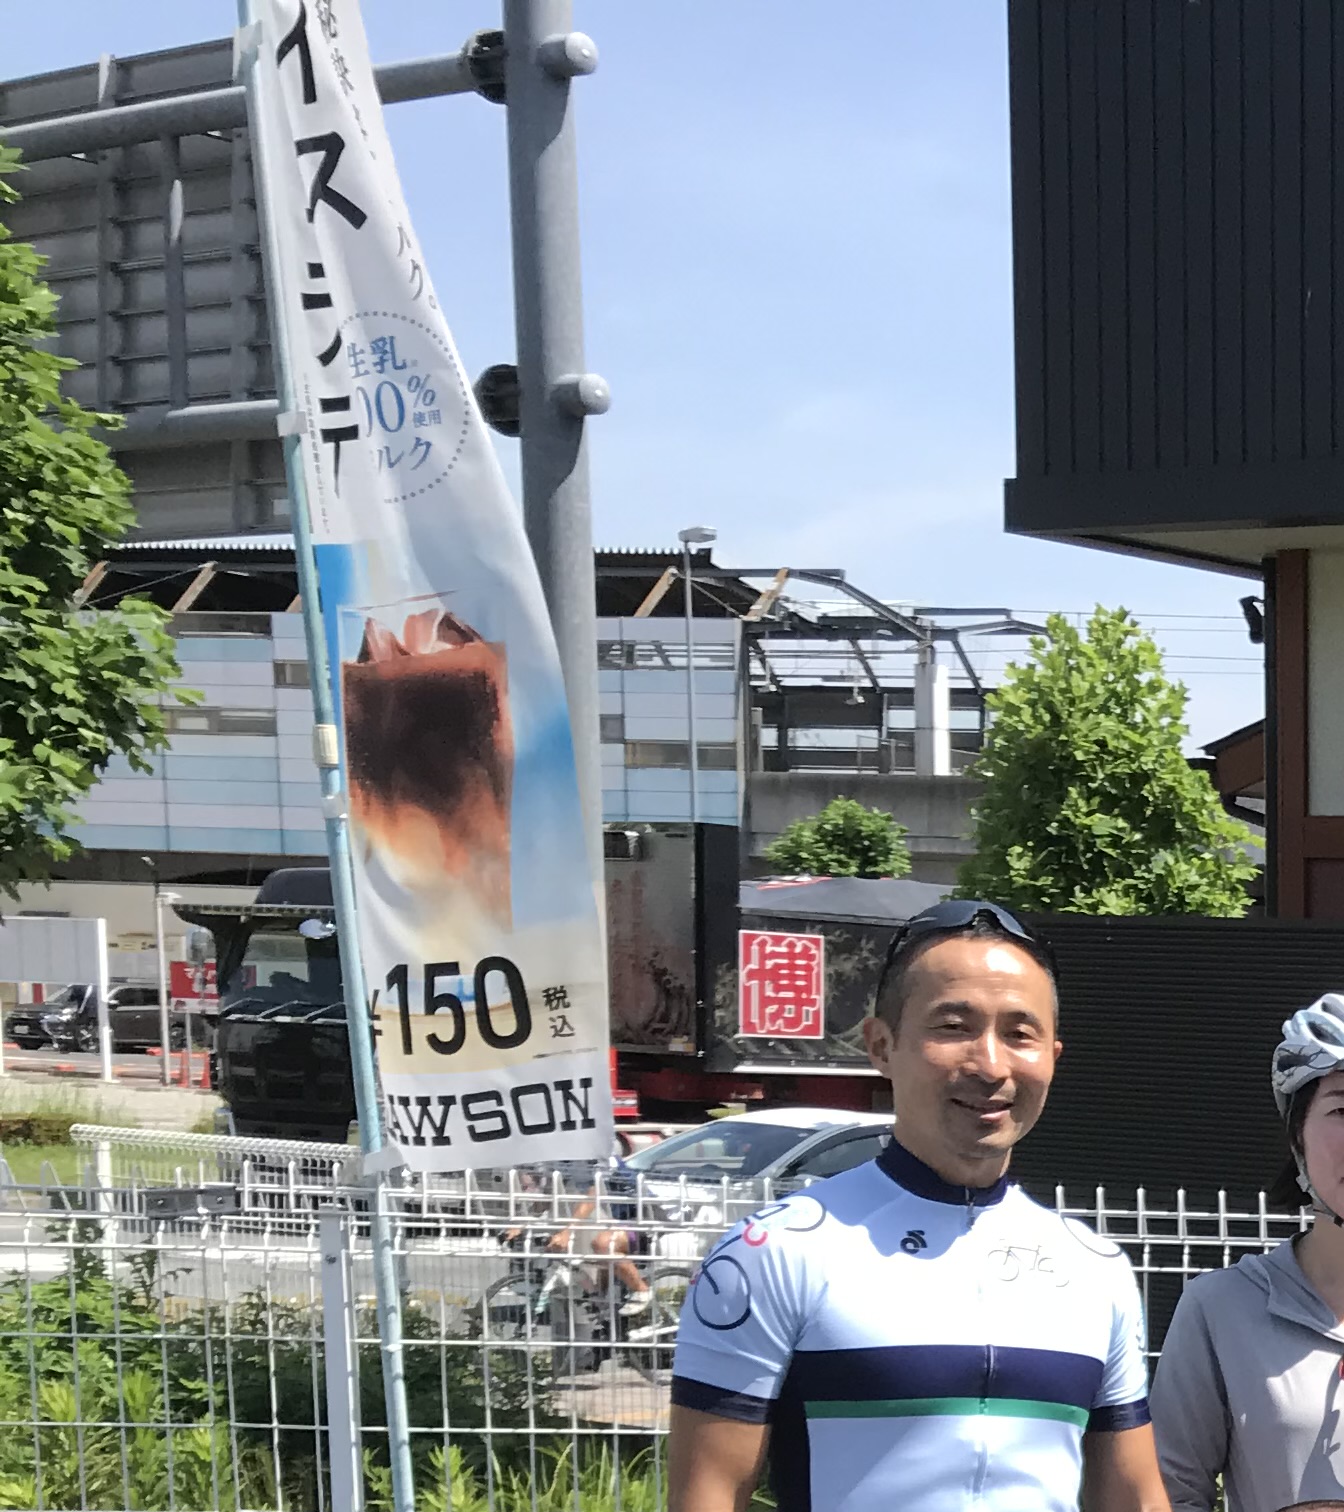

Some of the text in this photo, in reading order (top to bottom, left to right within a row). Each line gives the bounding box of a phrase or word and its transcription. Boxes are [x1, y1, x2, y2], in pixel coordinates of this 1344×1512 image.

[413, 409, 442, 428] 使用
[370, 436, 432, 476] ルク
[541, 985, 576, 1039] 税込
